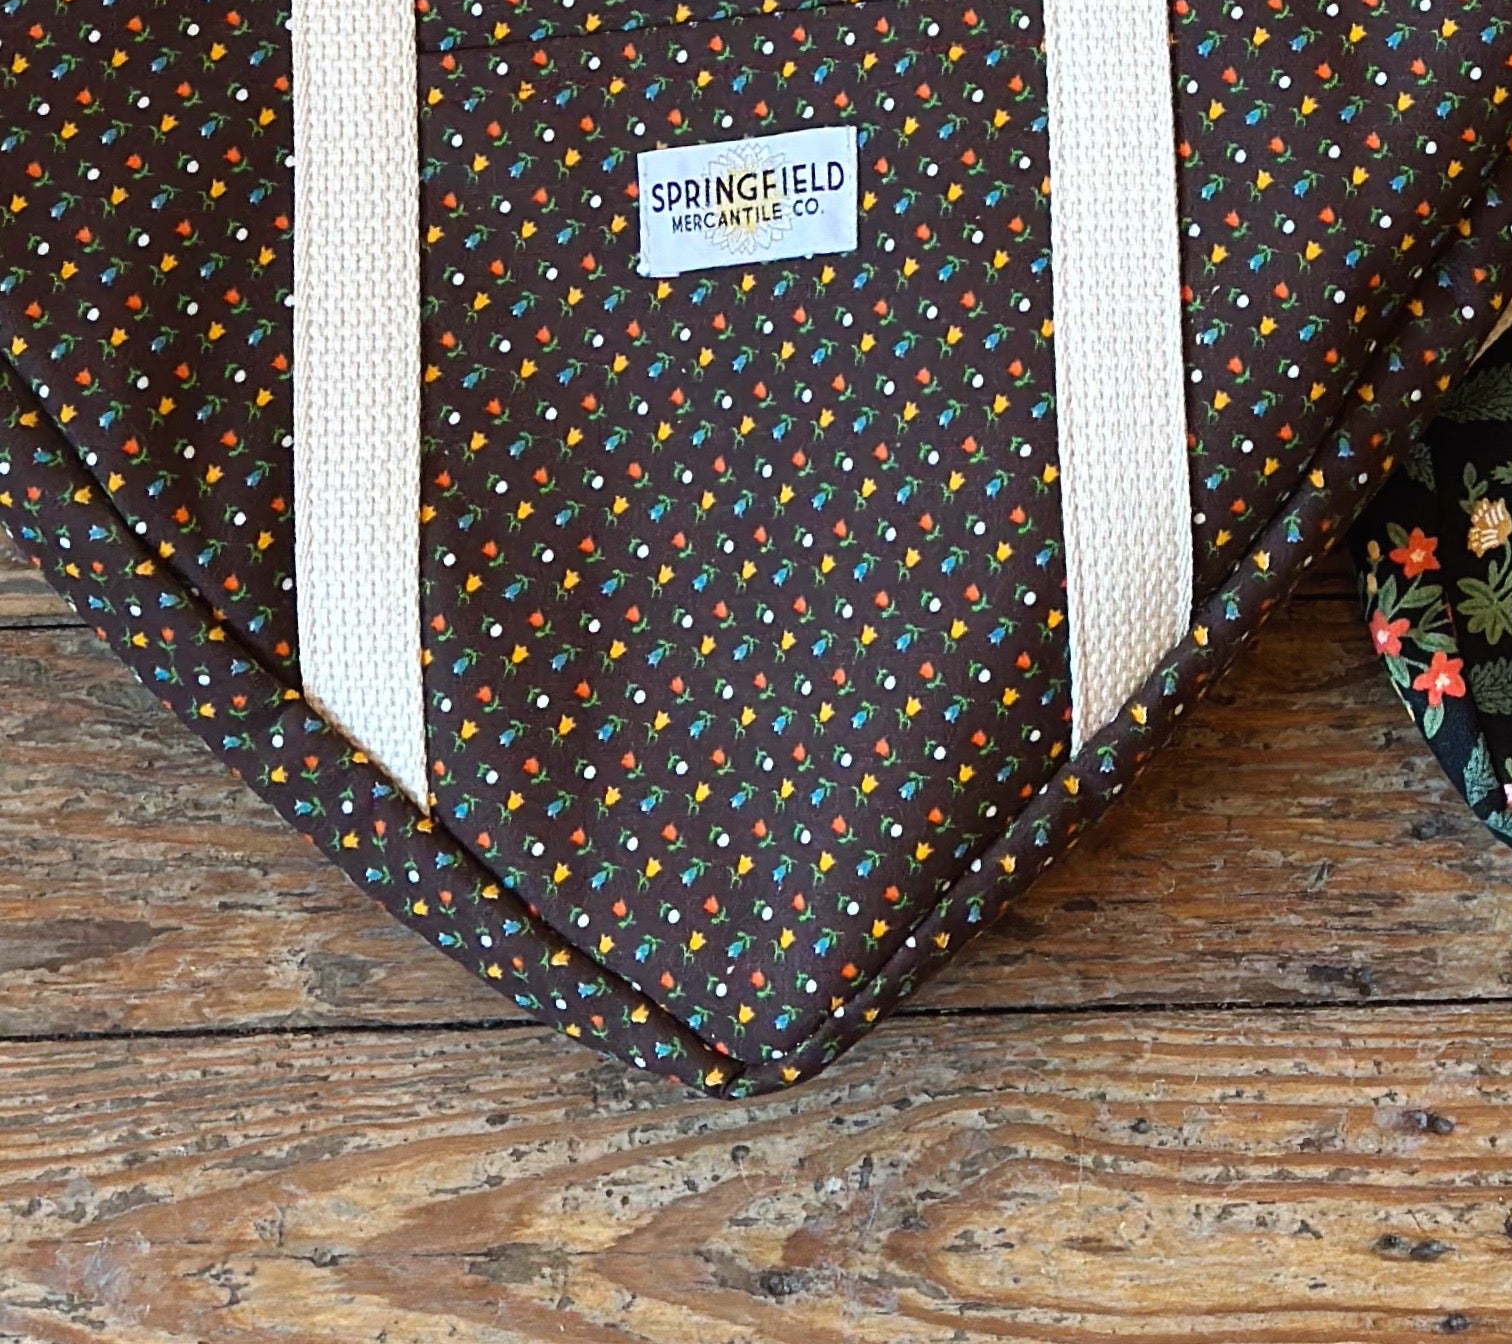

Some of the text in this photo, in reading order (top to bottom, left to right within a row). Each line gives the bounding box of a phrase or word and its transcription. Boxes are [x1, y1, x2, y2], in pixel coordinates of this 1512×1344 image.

[652, 161, 845, 213] SPRINGFIELD
[672, 197, 825, 234] MERCANTILE CO.
